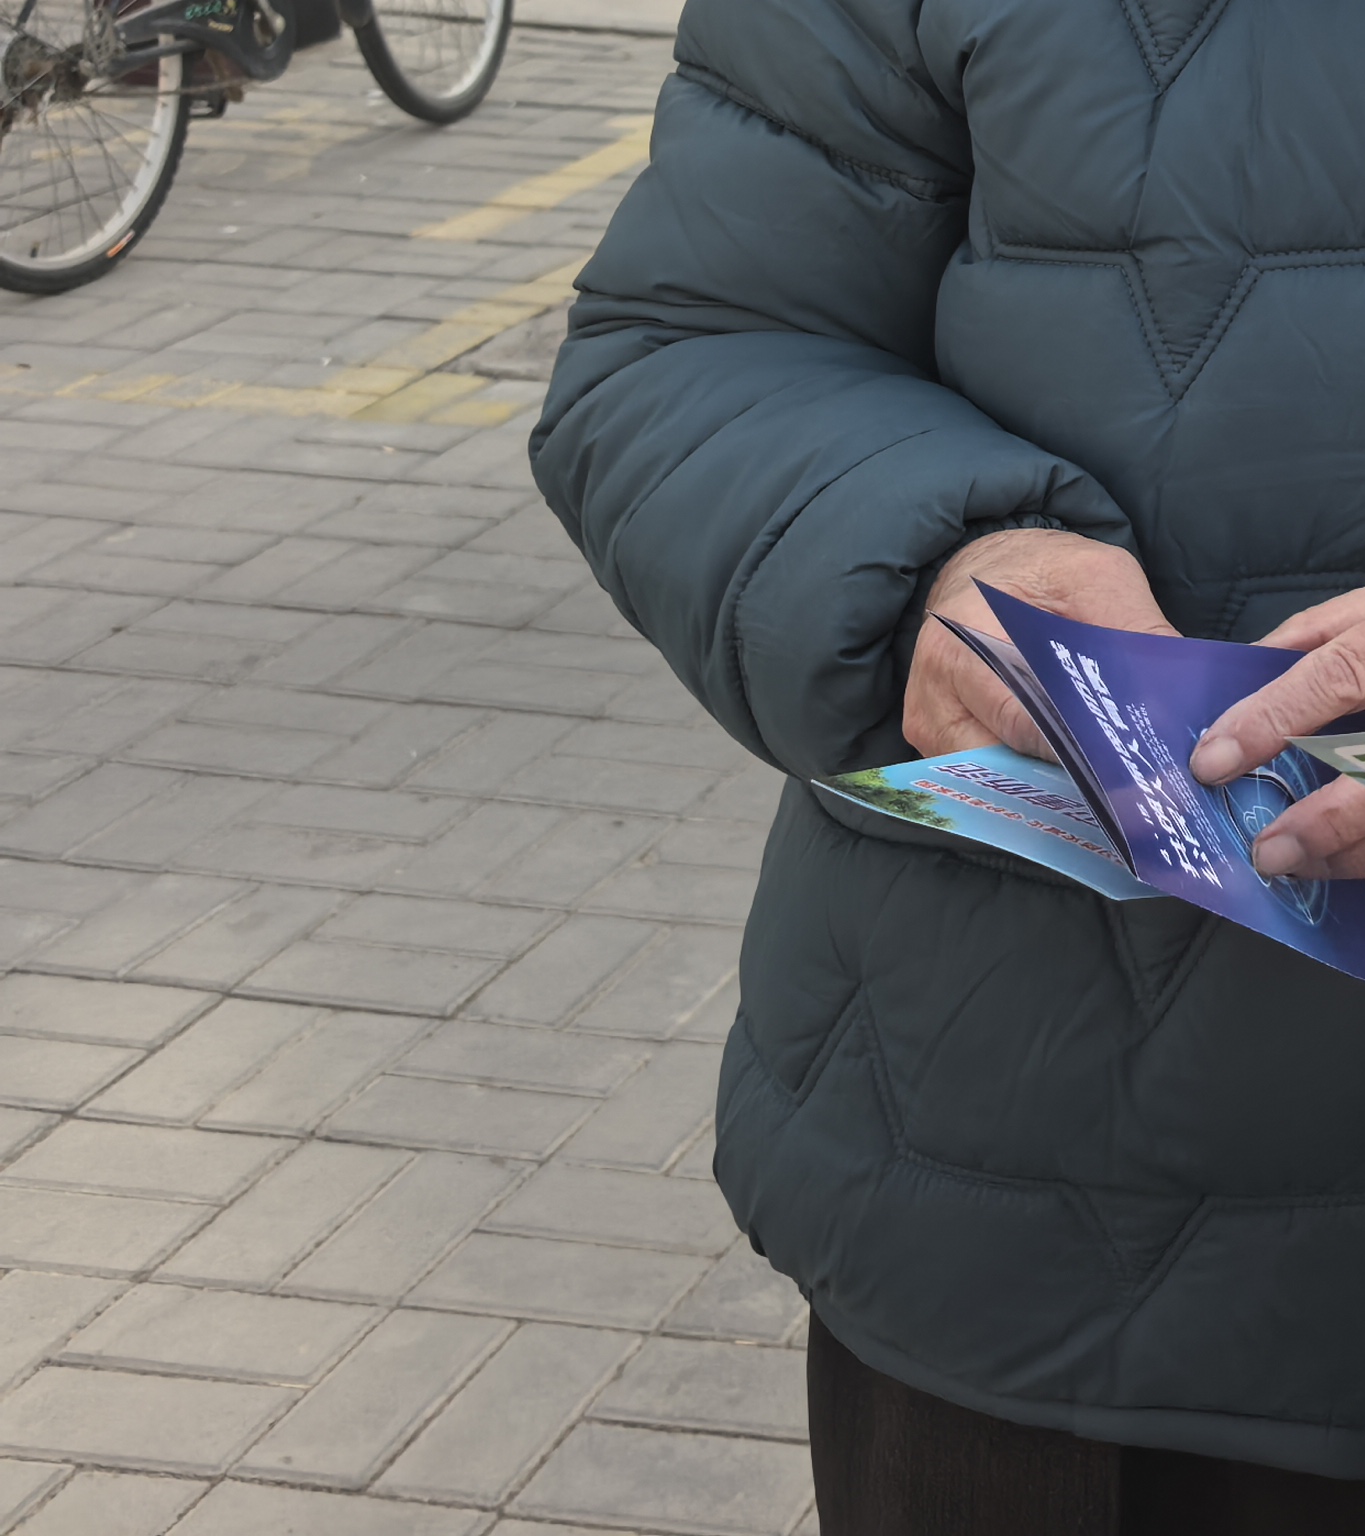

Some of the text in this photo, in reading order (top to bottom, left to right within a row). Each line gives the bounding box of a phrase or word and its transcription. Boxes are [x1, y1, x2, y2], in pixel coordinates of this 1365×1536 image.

[1049, 639, 1201, 880] 共筑保密防线
[1076, 652, 1224, 890] 公民人人有责
